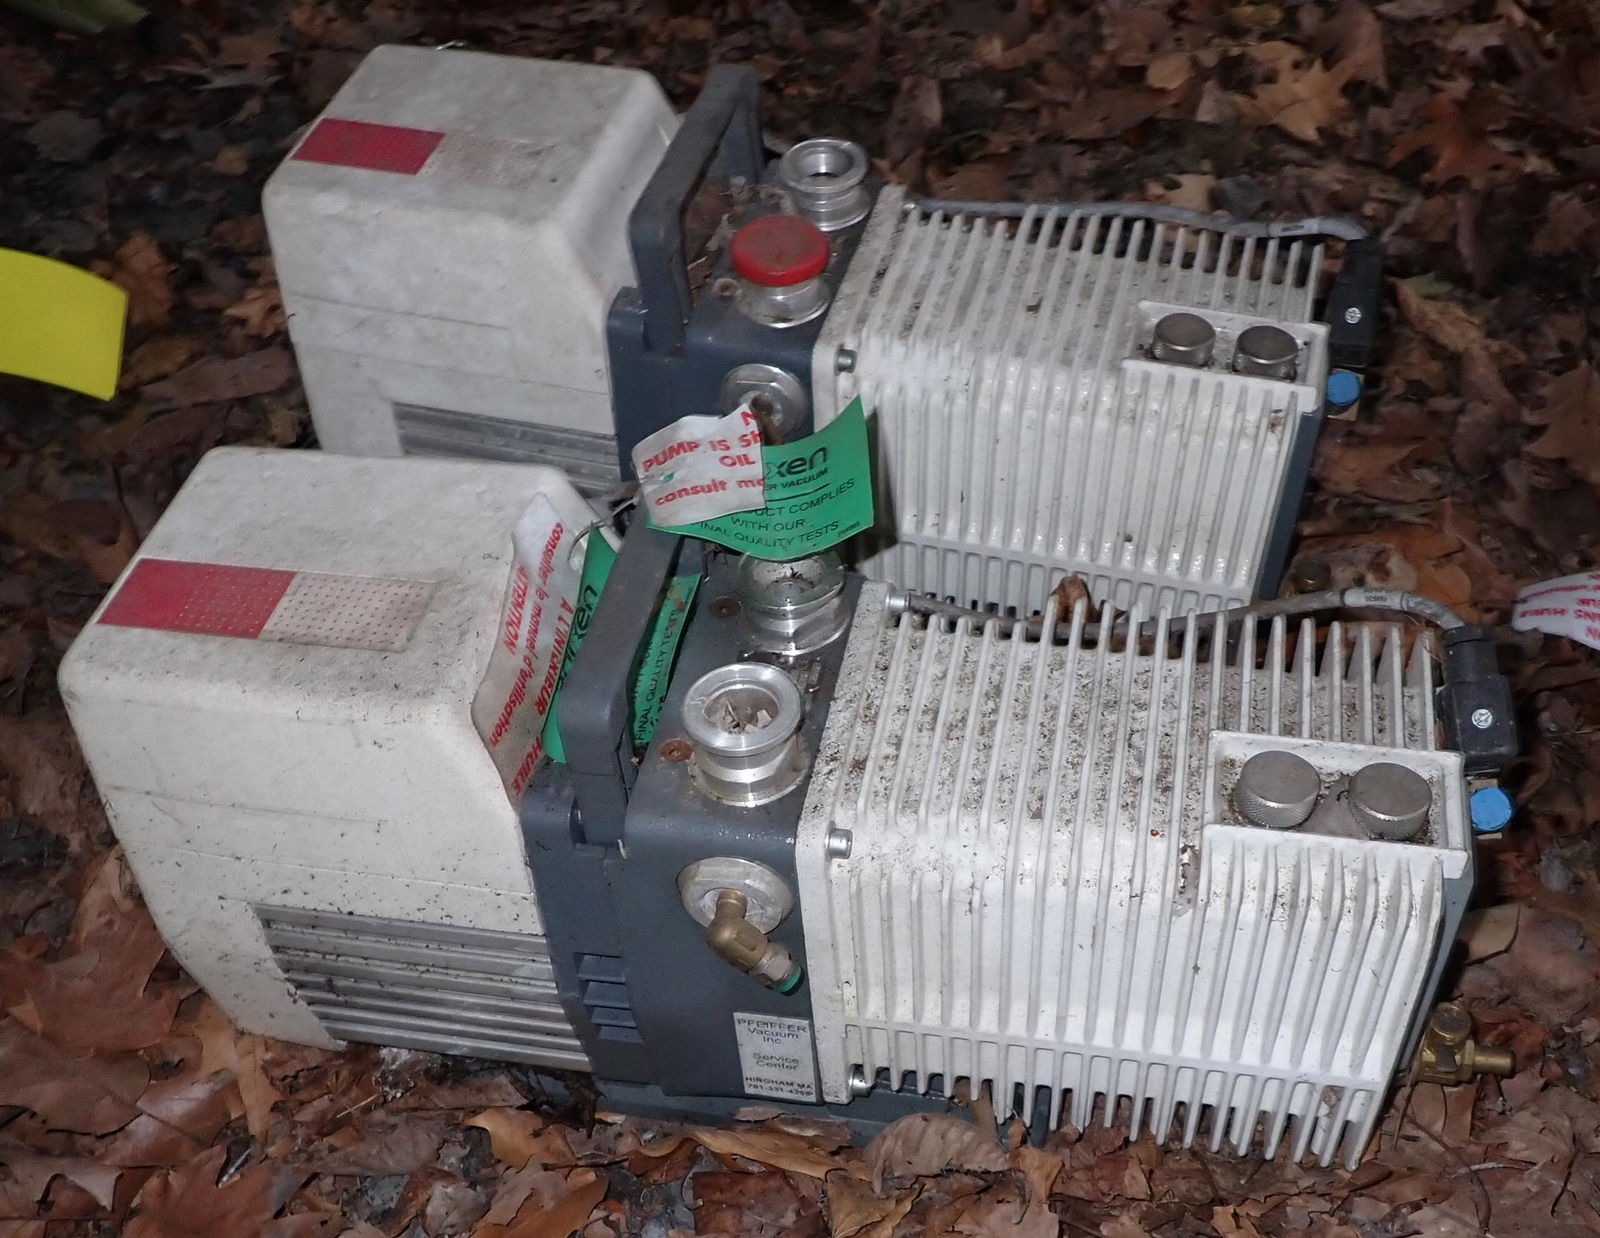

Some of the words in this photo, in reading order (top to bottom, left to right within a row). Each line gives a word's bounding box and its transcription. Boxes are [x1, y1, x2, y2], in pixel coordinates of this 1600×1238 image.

[642, 440, 701, 473] PUMP
[709, 439, 731, 452] IS
[718, 454, 756, 468] OIL
[780, 466, 829, 491] VACUUM
[654, 477, 729, 506] consult
[789, 478, 856, 514] COMPLIES
[730, 516, 769, 532] WITH
[774, 518, 806, 532] OUR
[699, 521, 730, 537] INAL
[734, 532, 795, 548] QUALITY
[798, 520, 840, 542] TESTS
[738, 1018, 807, 1033] PFEIFFER
[747, 1026, 799, 1039] Vacuum
[753, 1052, 800, 1064] Service
[756, 1060, 799, 1071] Center
